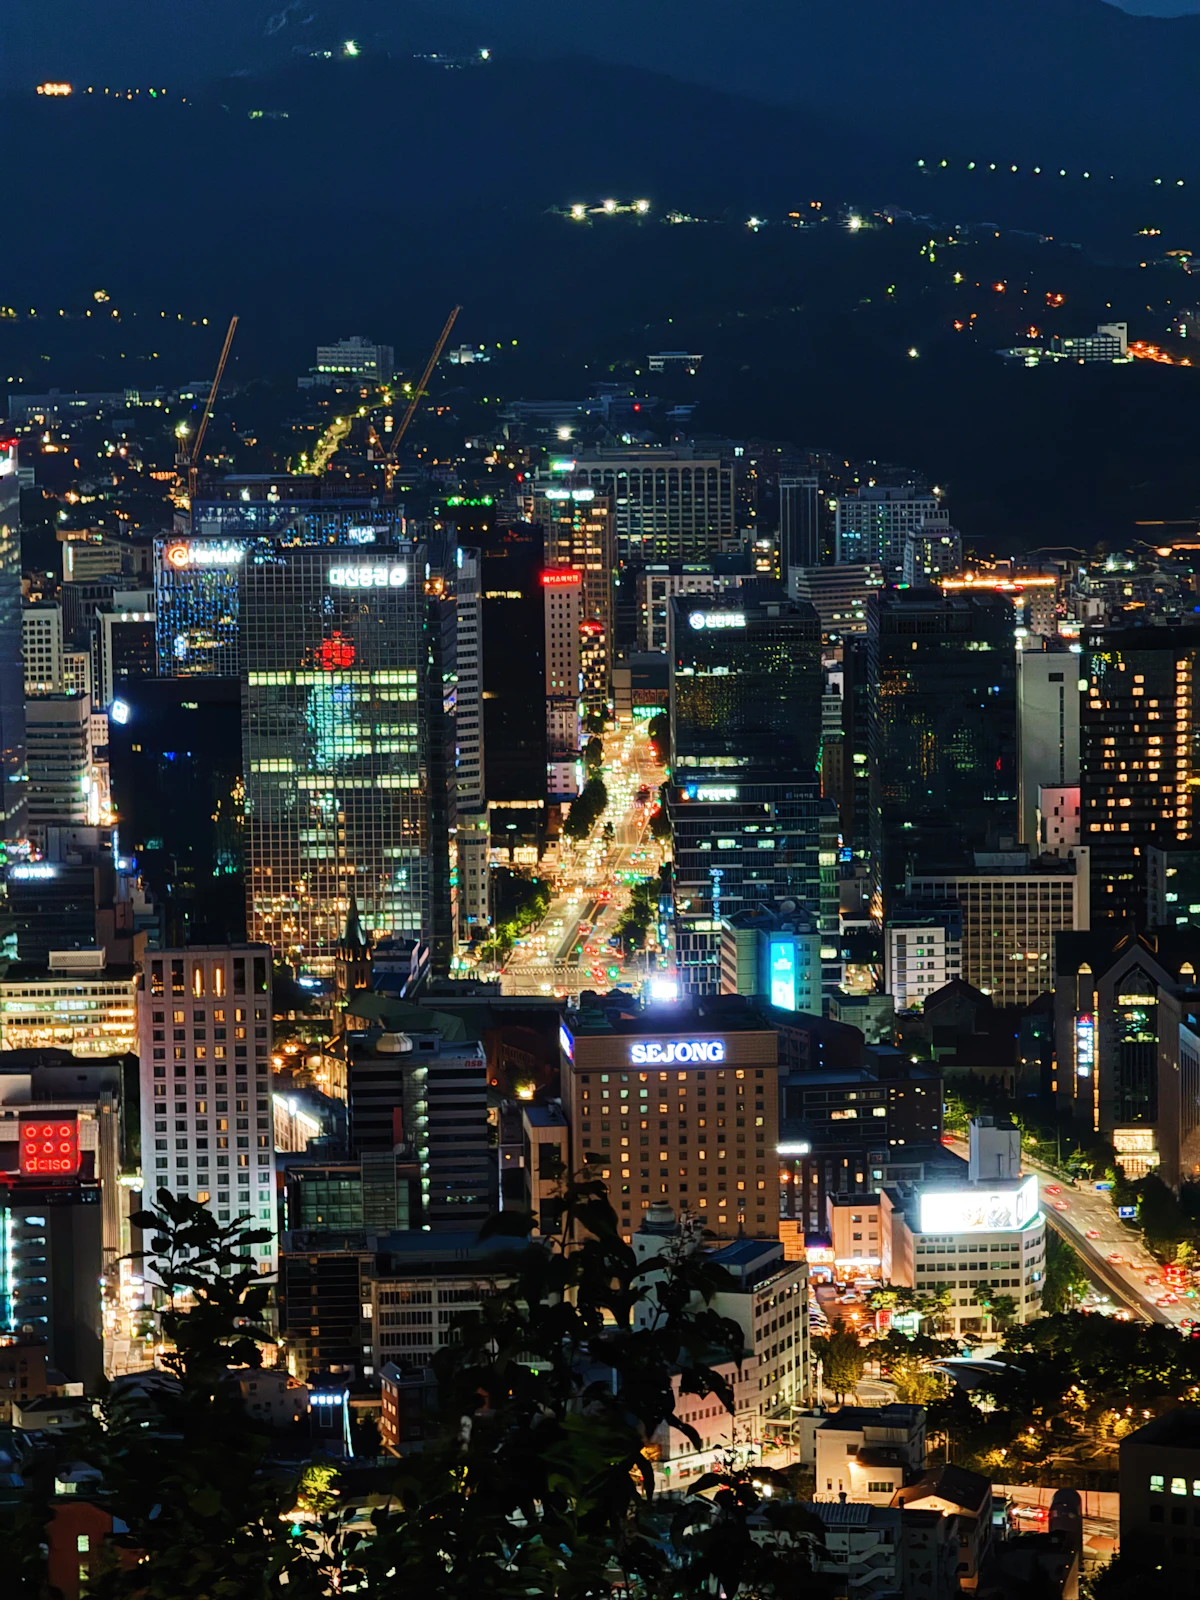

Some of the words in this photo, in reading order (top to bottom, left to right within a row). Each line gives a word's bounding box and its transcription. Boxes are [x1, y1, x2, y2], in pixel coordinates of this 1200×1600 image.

[188, 548, 244, 564] Hanwh
[329, 567, 388, 587] 대신증권
[705, 614, 746, 628] 신한카드
[631, 1042, 724, 1063] SEJONG
[26, 1157, 71, 1172] daiso
